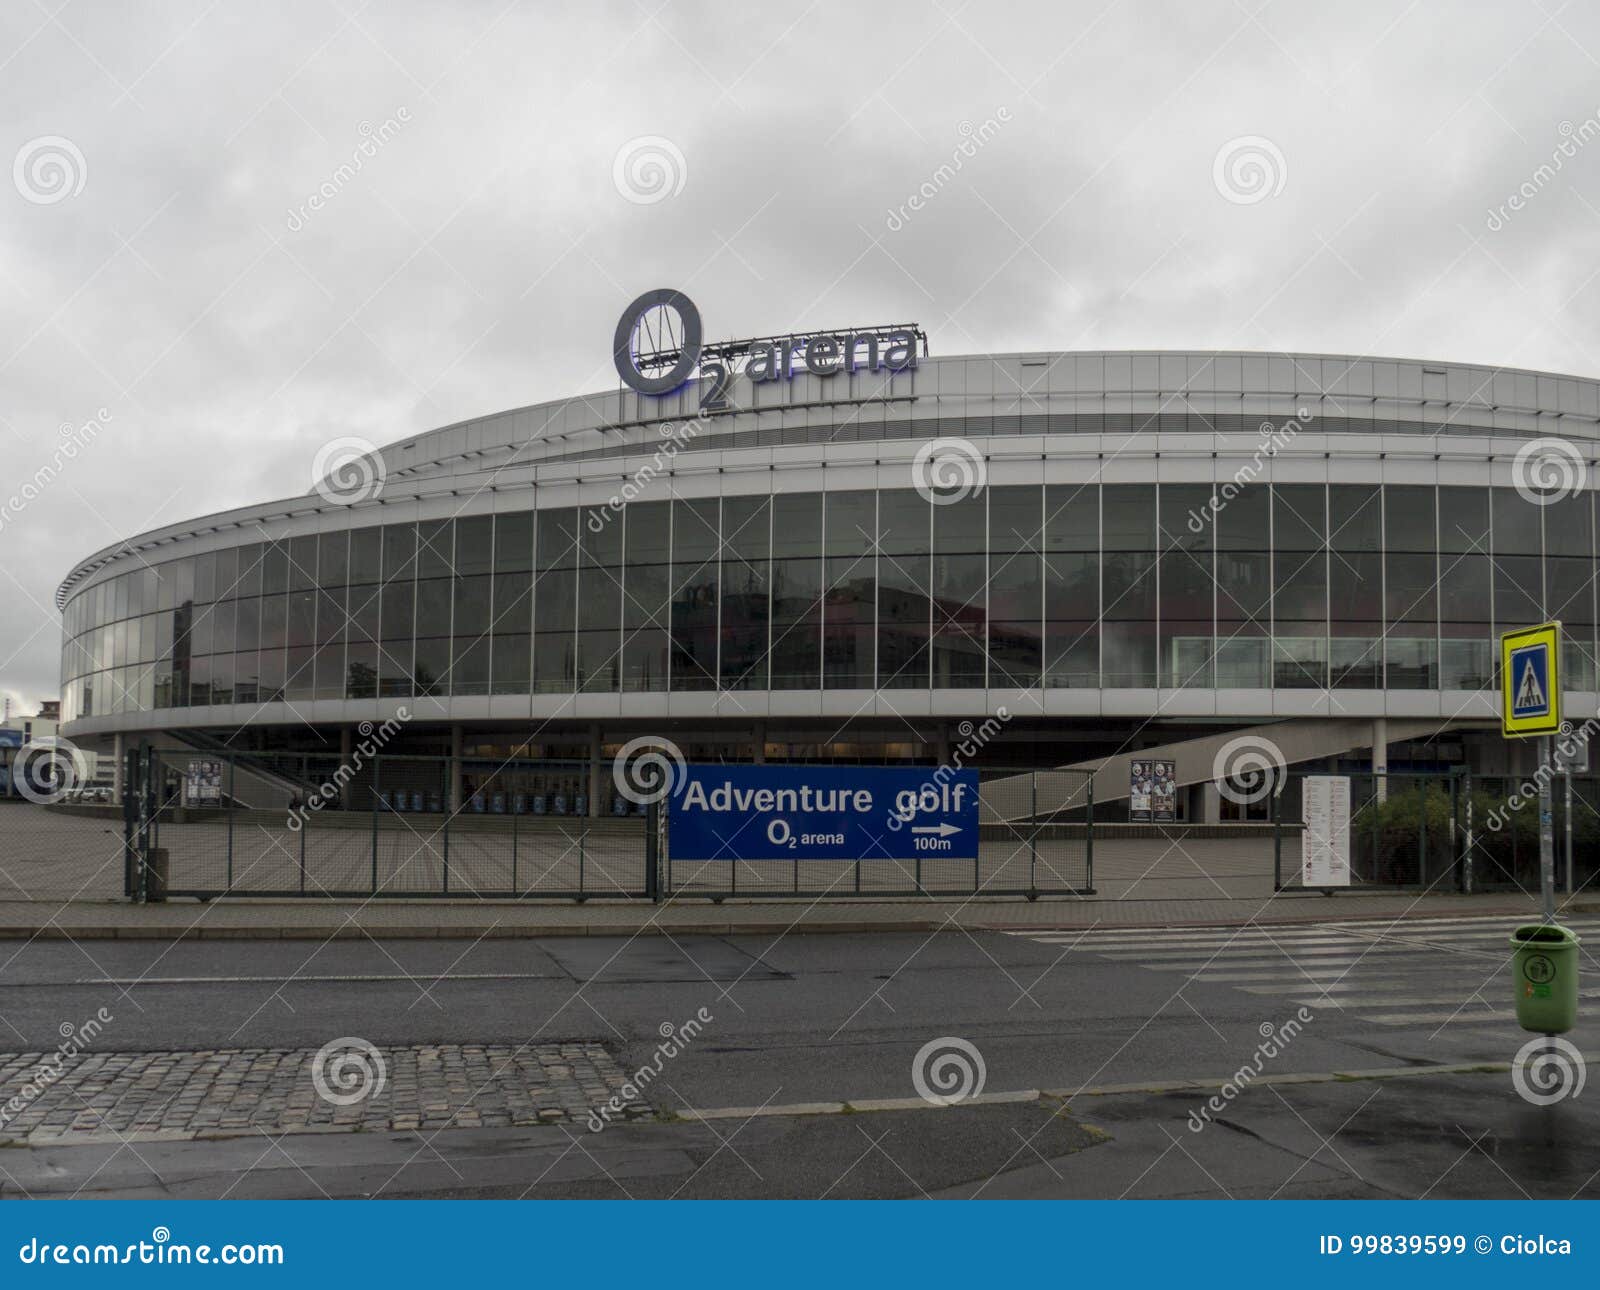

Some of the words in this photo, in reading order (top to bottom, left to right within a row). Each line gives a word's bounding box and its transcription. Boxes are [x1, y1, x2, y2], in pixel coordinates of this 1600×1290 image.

[745, 328, 918, 383] arena
[682, 781, 873, 812] Adventure
[896, 783, 967, 822] golf
[801, 833, 845, 845] arena
[913, 837, 951, 850] 100m
